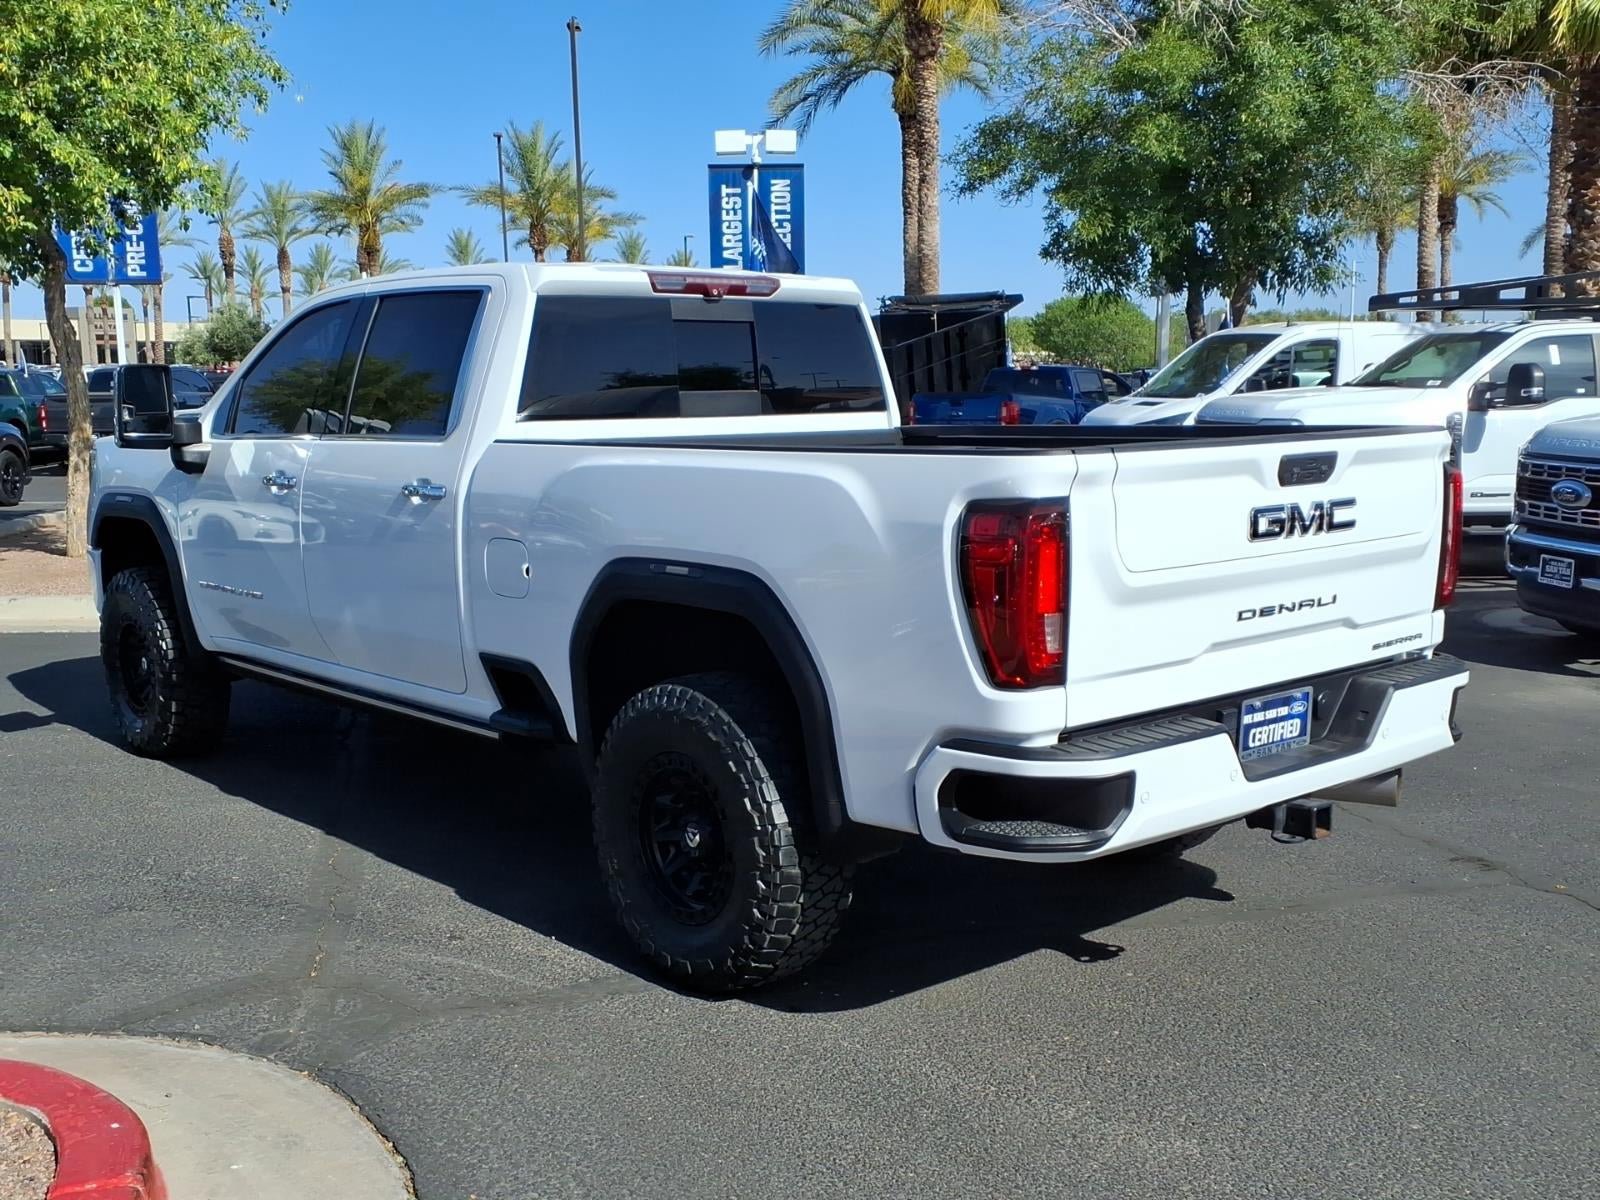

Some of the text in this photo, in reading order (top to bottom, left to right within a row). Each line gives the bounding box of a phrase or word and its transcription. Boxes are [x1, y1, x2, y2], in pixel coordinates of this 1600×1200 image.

[721, 184, 743, 269] LARGEST
[1247, 497, 1357, 542] GMC
[1237, 594, 1337, 622] DENALI
[1372, 633, 1423, 650] SIERRA
[1249, 718, 1301, 748] CERTIFIED
